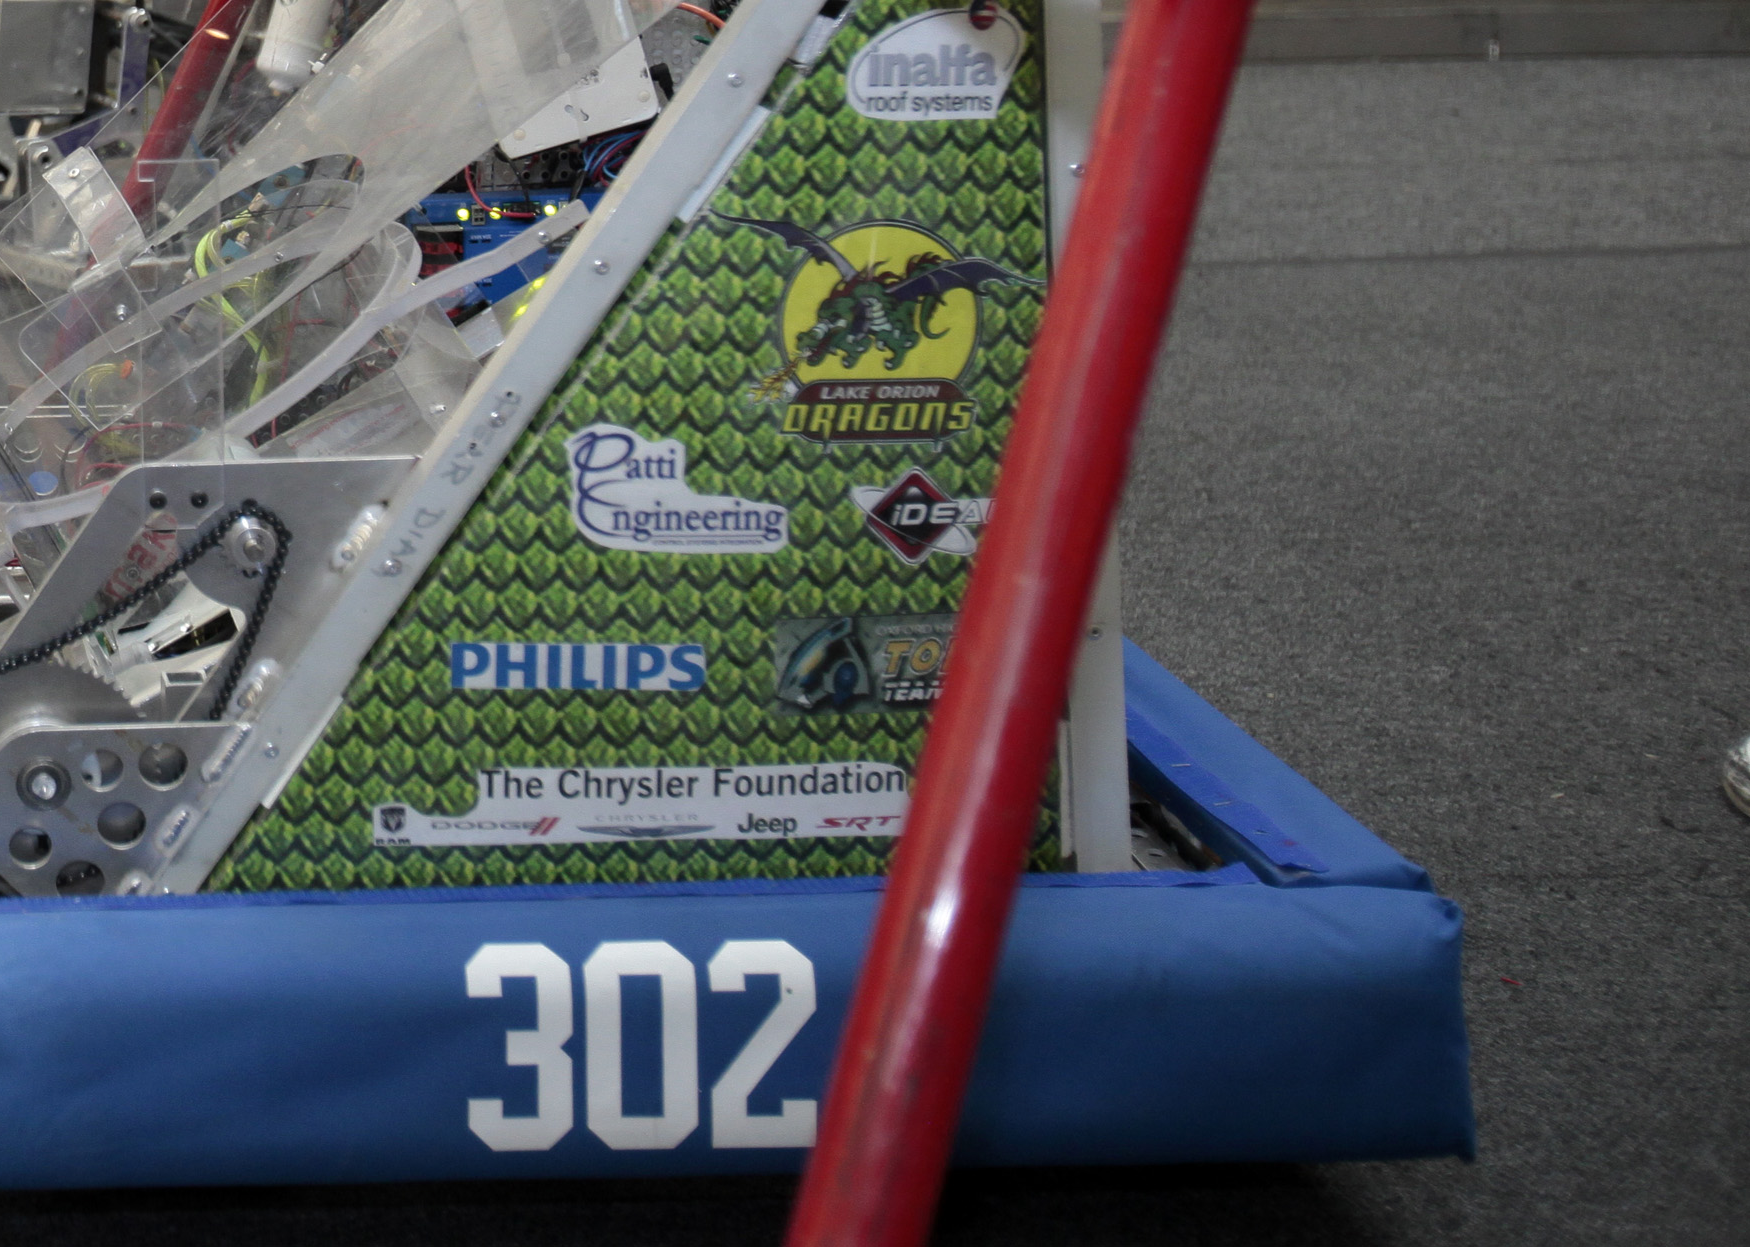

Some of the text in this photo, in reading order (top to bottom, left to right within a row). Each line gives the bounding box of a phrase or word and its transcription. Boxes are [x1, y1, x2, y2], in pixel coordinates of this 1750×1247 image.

[867, 42, 997, 87] inalfa
[867, 91, 993, 116] roof systems
[820, 384, 940, 400] LAKE ORION
[782, 401, 975, 442] DRAGONS
[572, 431, 678, 480] Patti
[577, 479, 785, 542] Engineering
[451, 642, 706, 691] PHILIPS
[481, 763, 905, 805] The Chrysler Foundation
[431, 819, 541, 831] DODGE
[595, 813, 698, 822] CHRYSLER
[737, 812, 798, 836] Jeep
[816, 815, 901, 831] SRT
[465, 939, 818, 1152] 302
